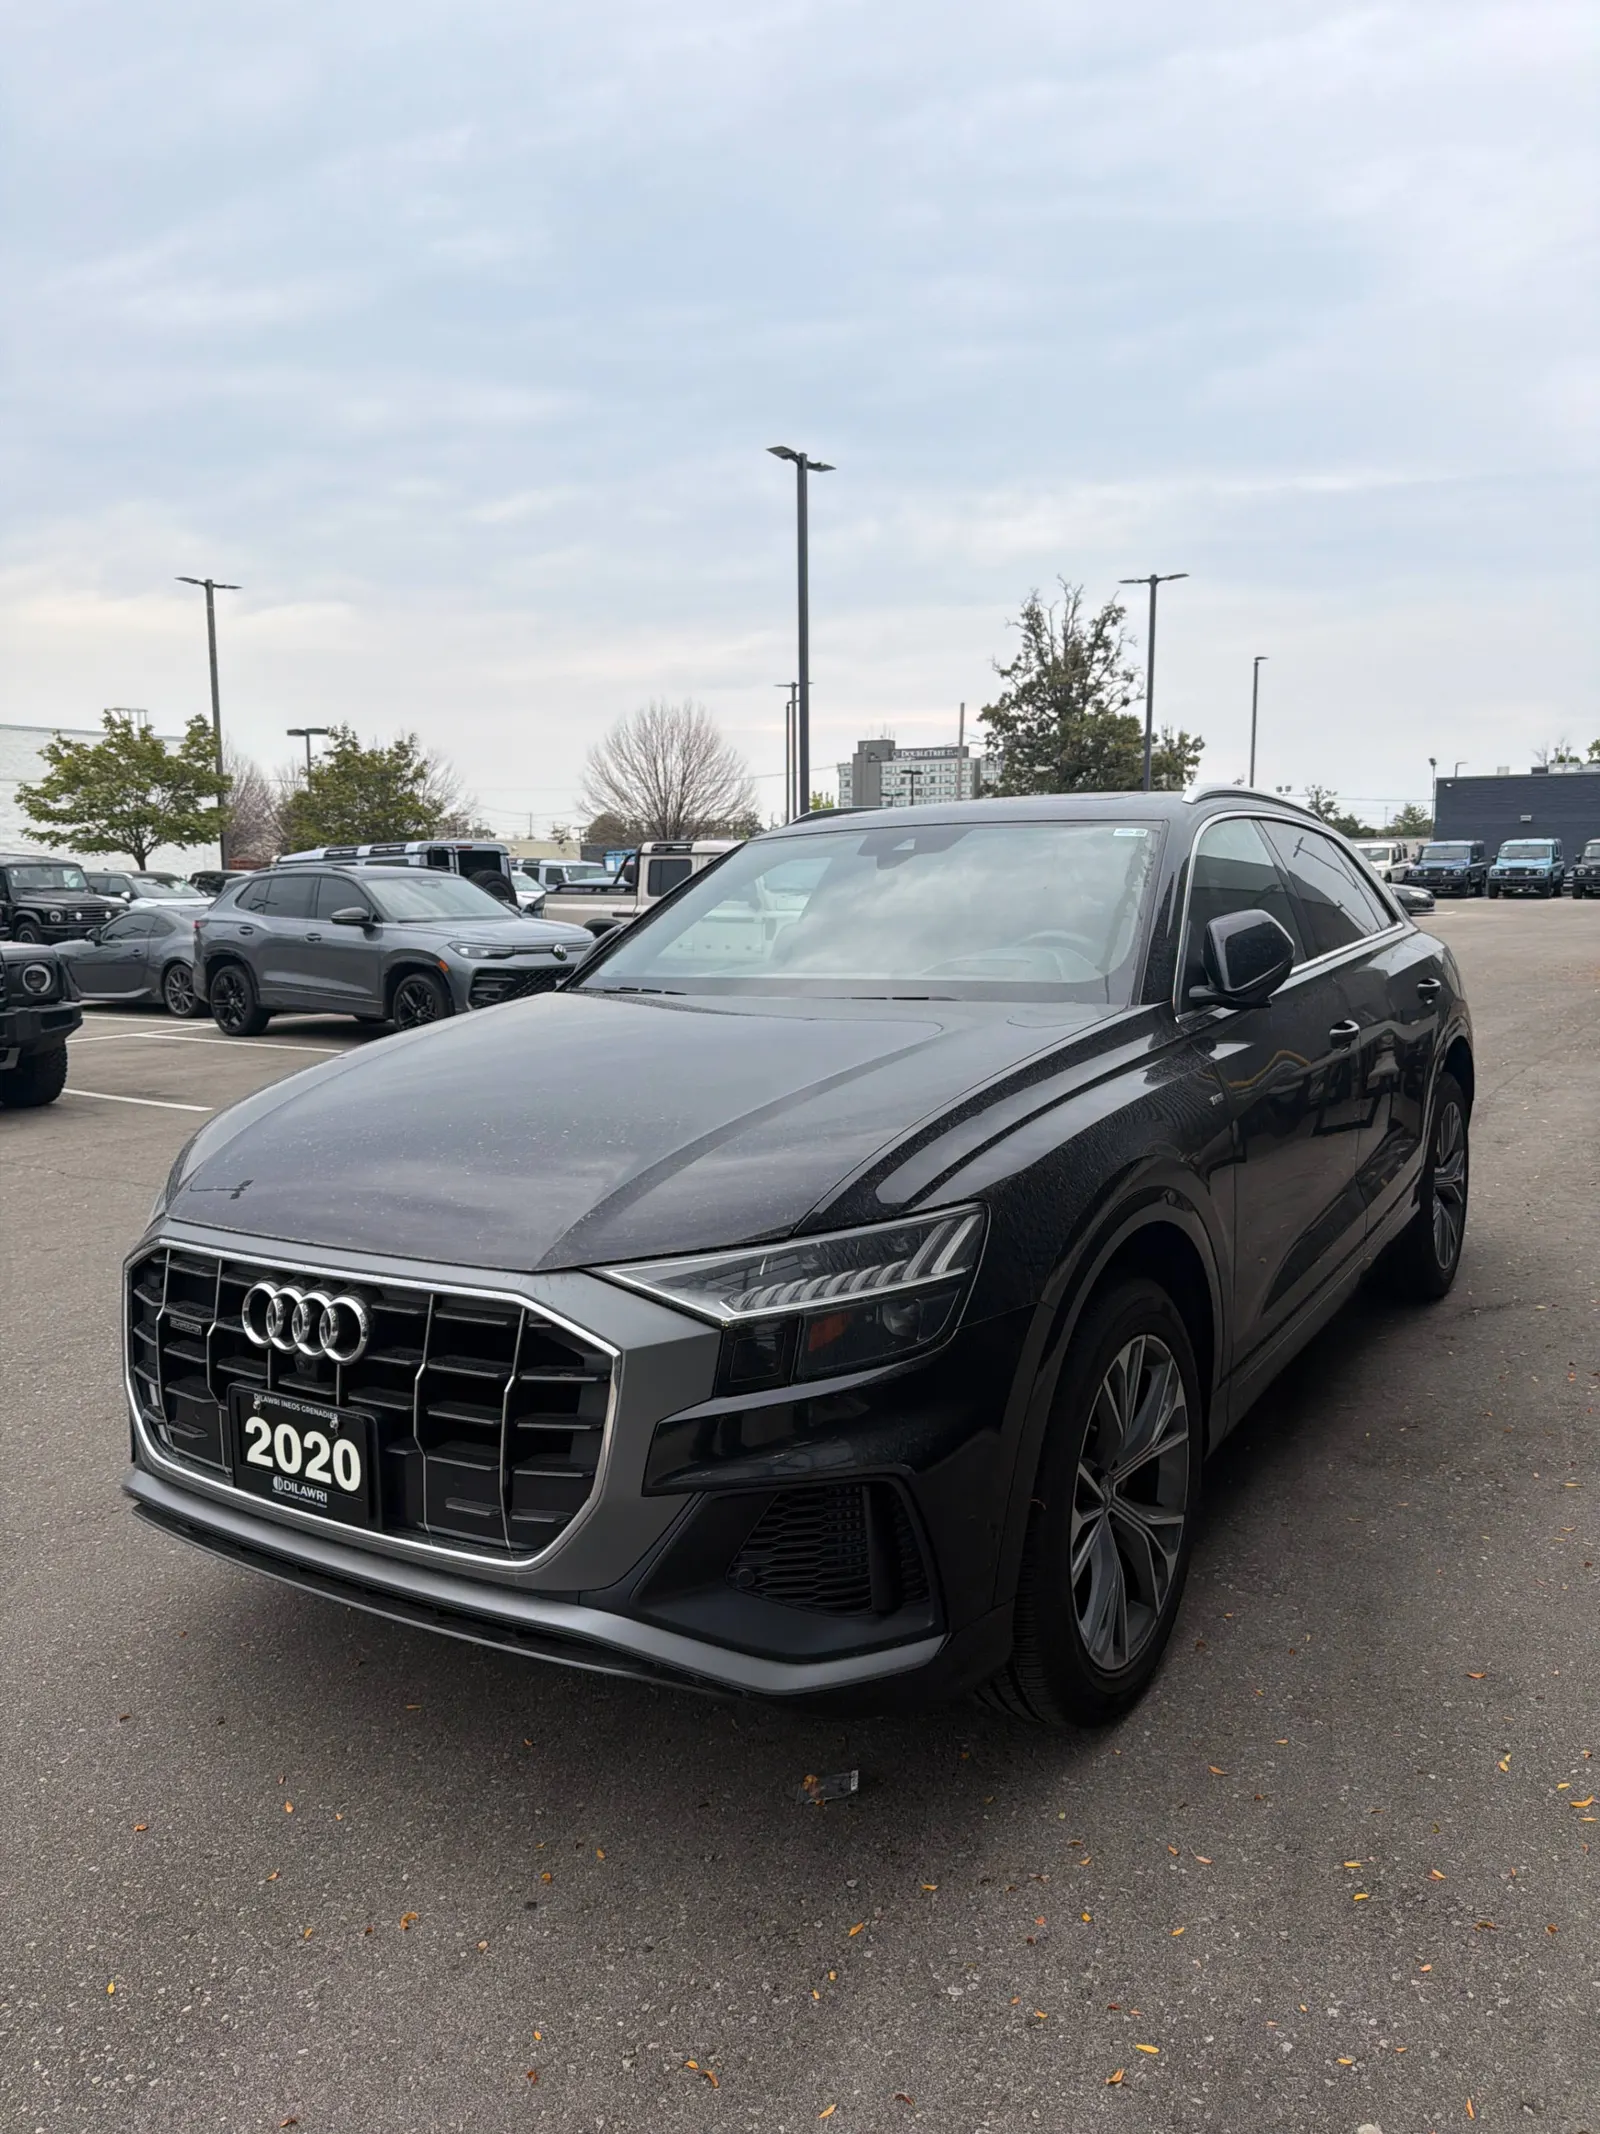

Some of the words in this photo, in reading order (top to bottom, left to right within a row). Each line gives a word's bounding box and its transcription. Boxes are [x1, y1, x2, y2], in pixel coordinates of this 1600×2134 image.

[253, 1393, 280, 1405] DILAWRI
[281, 1399, 300, 1411] INEOS
[301, 1405, 338, 1420] GRENADIER
[245, 1416, 361, 1492] 2020
[283, 1480, 328, 1503] DILAWRI
